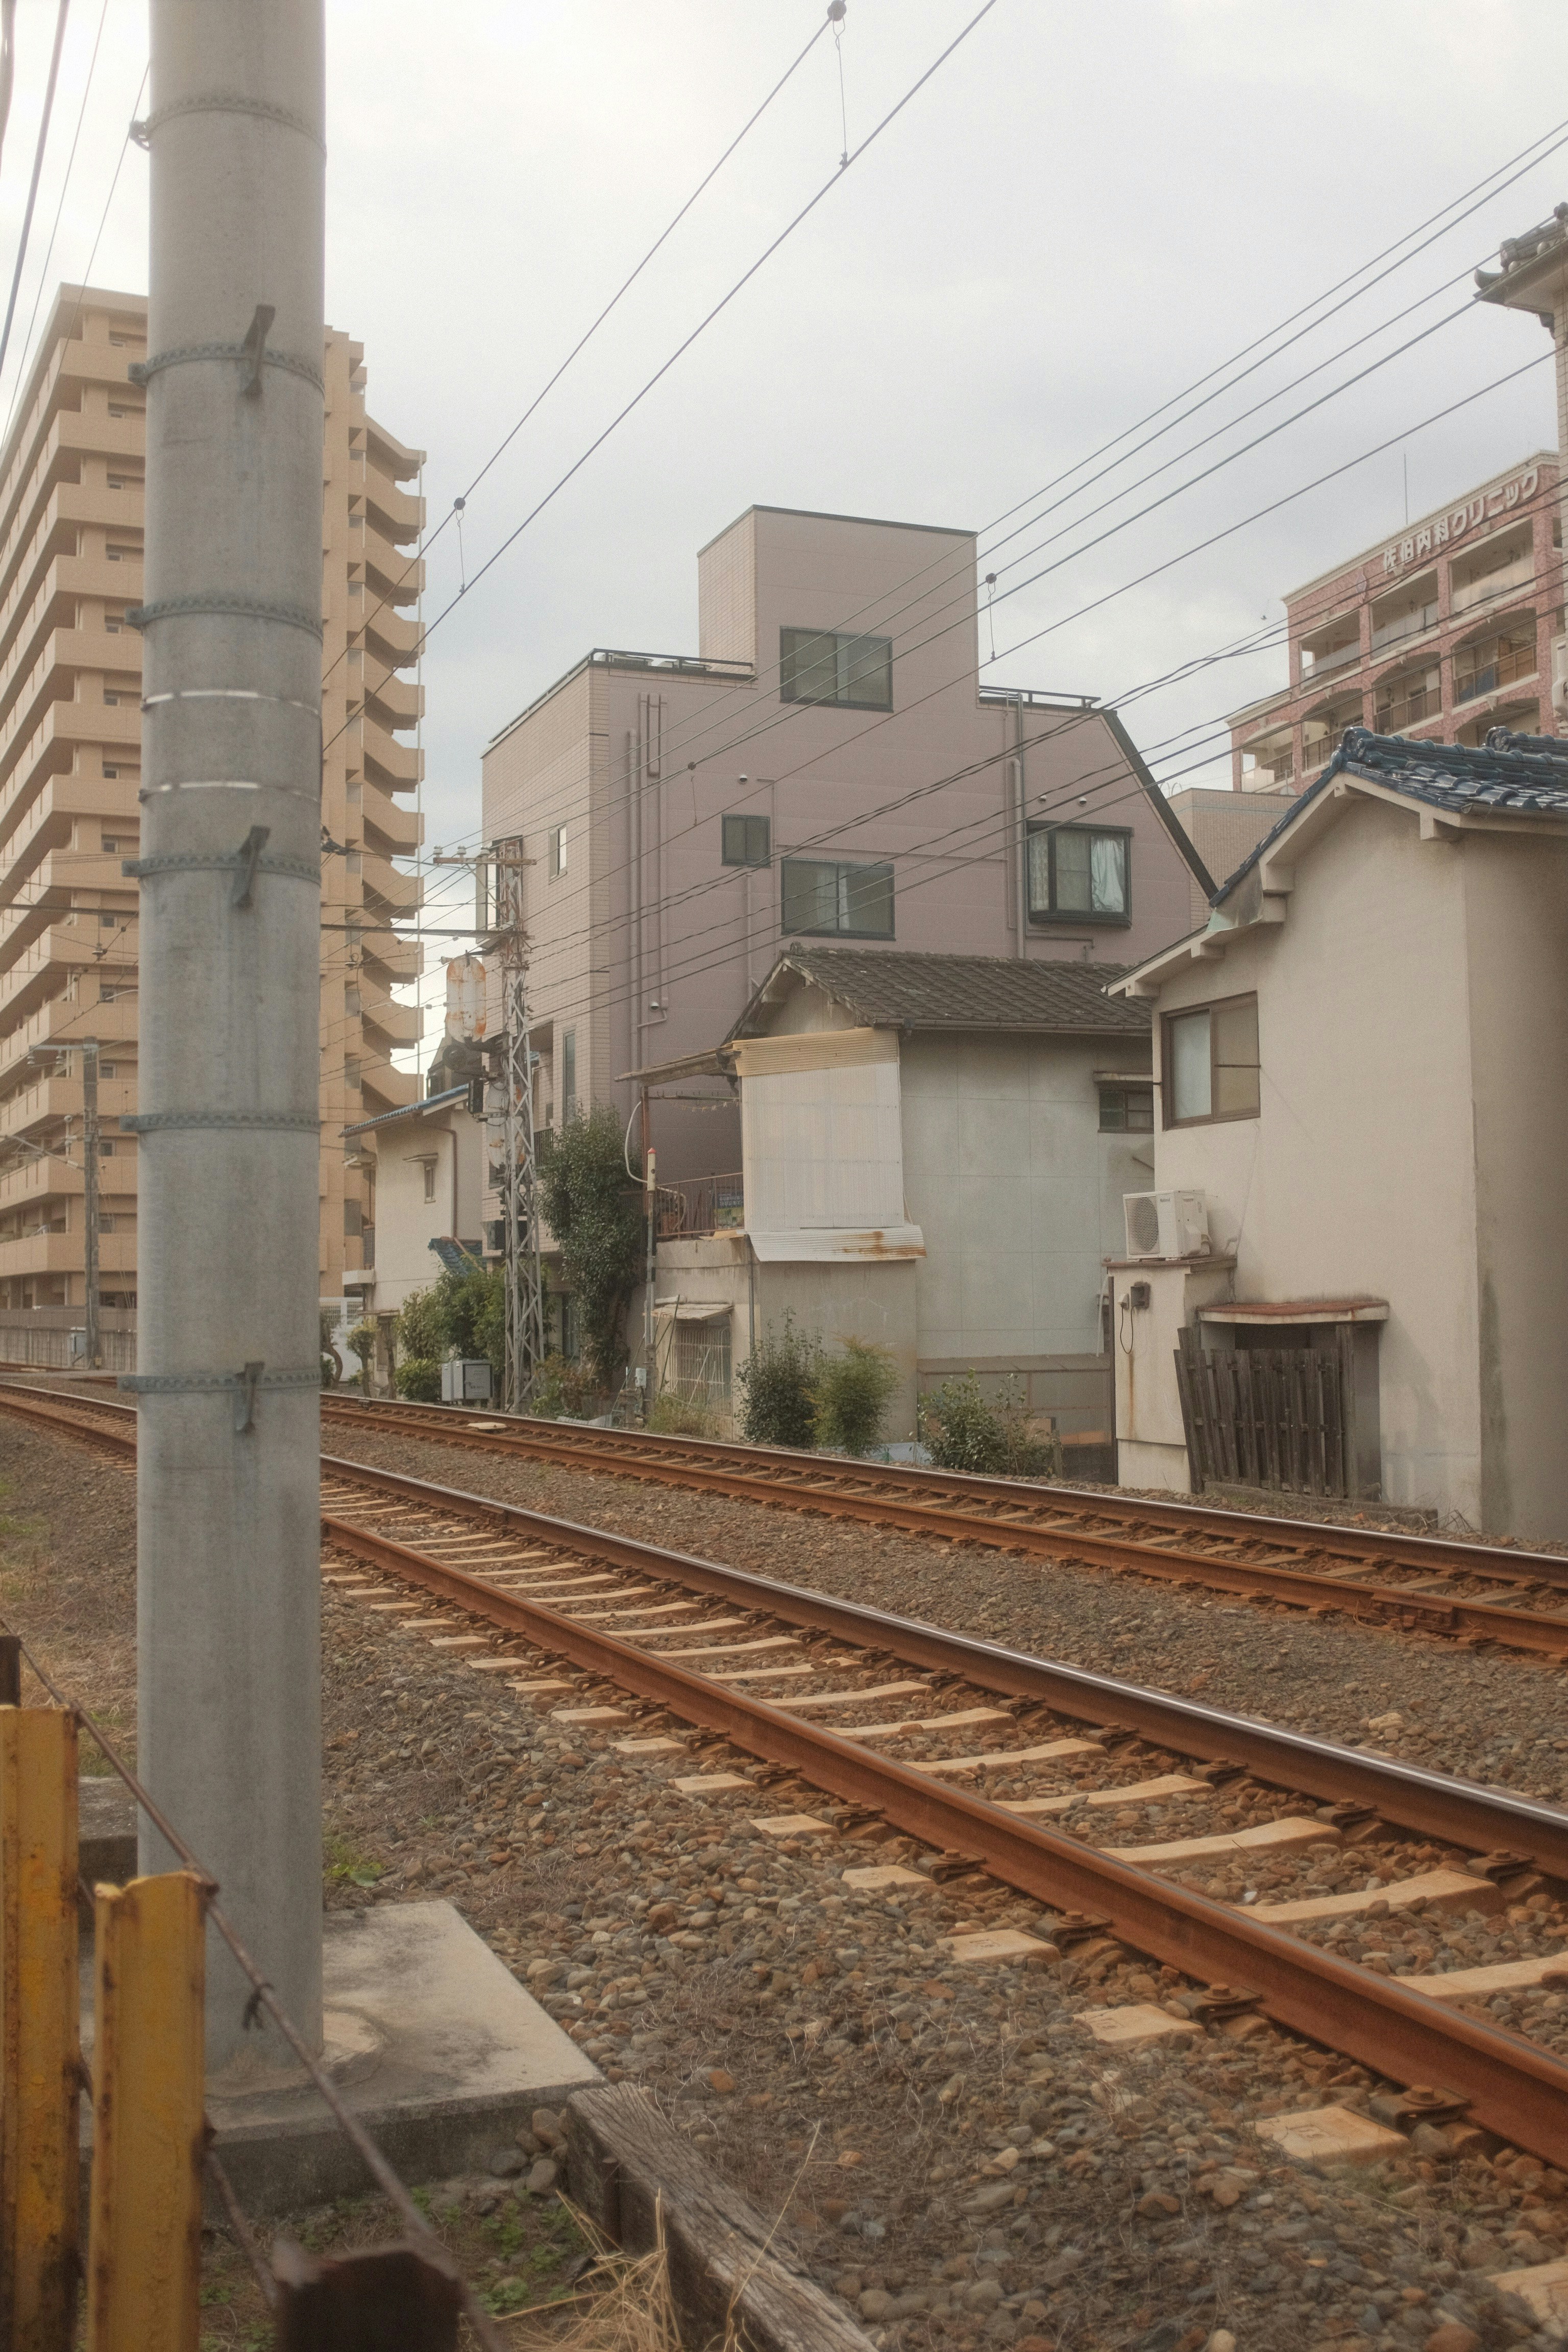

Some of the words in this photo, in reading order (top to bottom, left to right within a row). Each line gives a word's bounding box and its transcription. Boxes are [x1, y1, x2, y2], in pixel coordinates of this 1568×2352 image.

[1383, 467, 1538, 575] 佐伯内科クリニック
